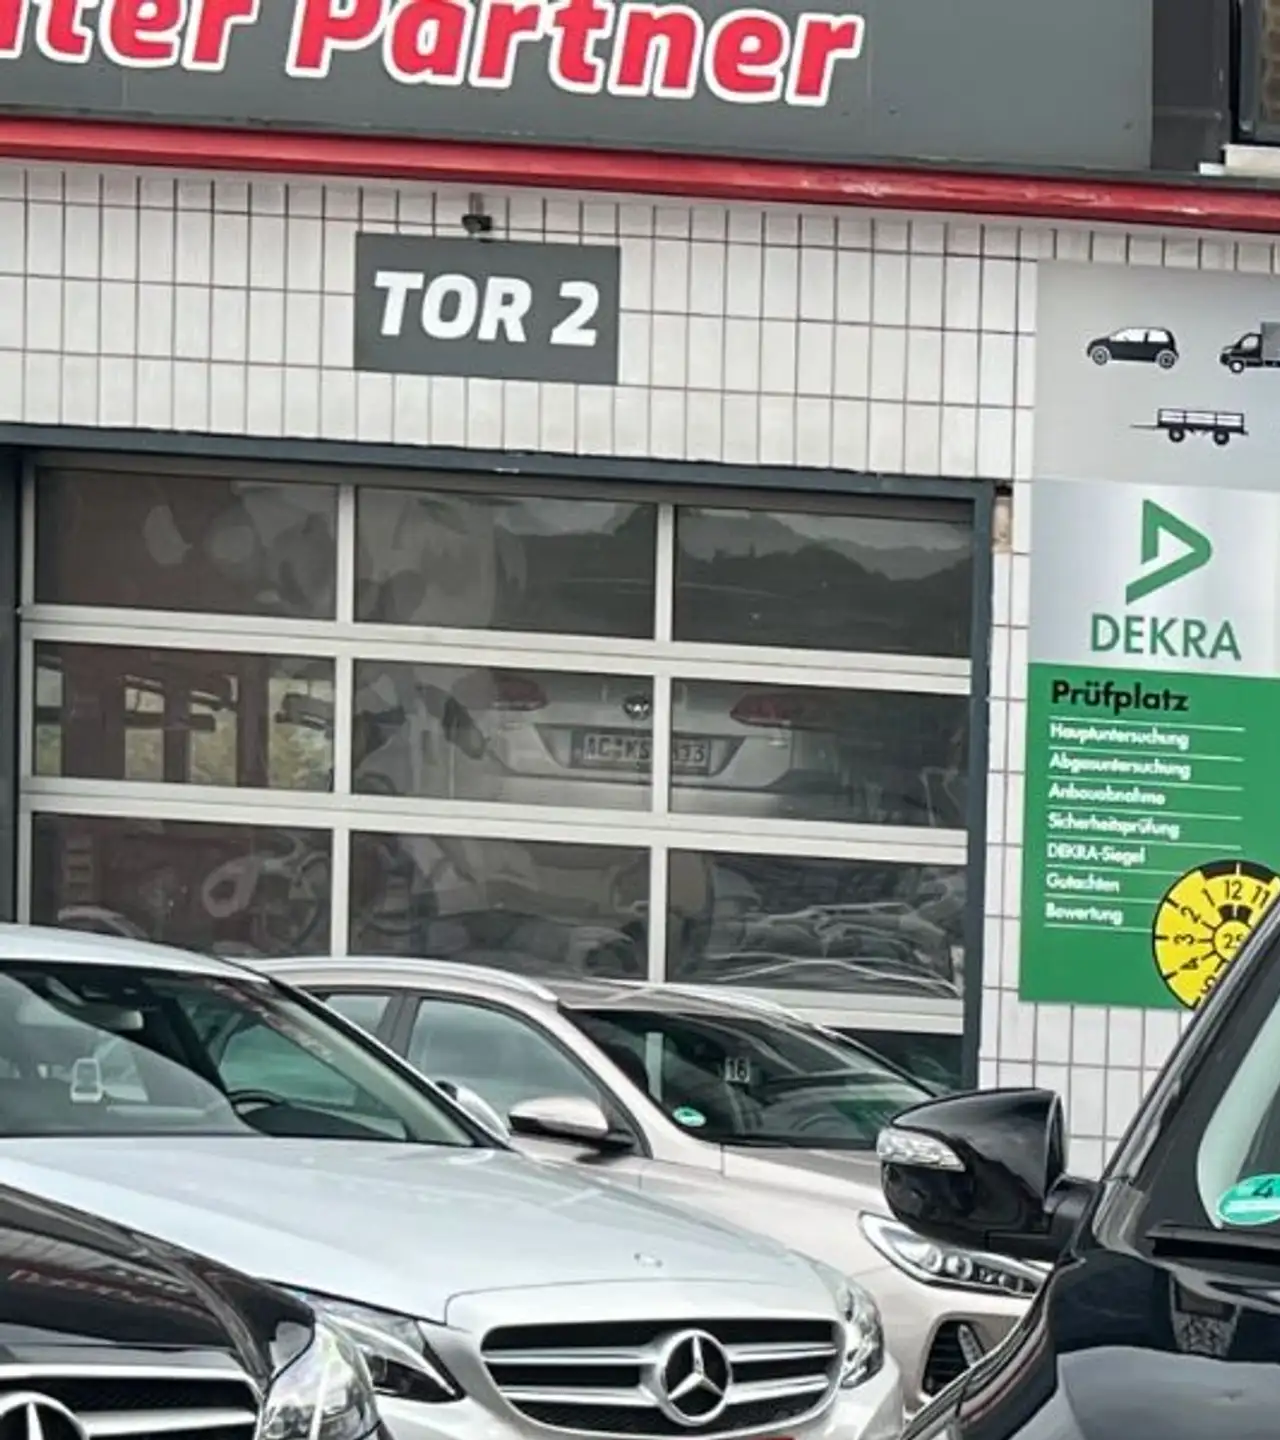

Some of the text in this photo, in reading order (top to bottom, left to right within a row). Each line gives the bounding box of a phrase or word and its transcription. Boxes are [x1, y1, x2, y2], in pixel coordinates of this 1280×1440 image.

[285, 0, 865, 107] Partner
[375, 271, 600, 348] TOR 2
[1090, 613, 1242, 662] DEKRA
[1051, 679, 1190, 716] Prüfplatz
[1049, 723, 1190, 751] Hauptuntersuchung
[1048, 752, 1192, 780] Abgasuntersuchung
[1048, 782, 1166, 806] Anbauabnahme
[1047, 812, 1181, 840] Sicherheitsprüfung
[1046, 843, 1146, 867] DEKRA-Siegel
[1045, 872, 1120, 894] Gutachten
[1224, 880, 1243, 900] 12
[1045, 902, 1123, 926] Bewertung
[1180, 906, 1202, 923] 2
[1252, 1178, 1276, 1198] 4
